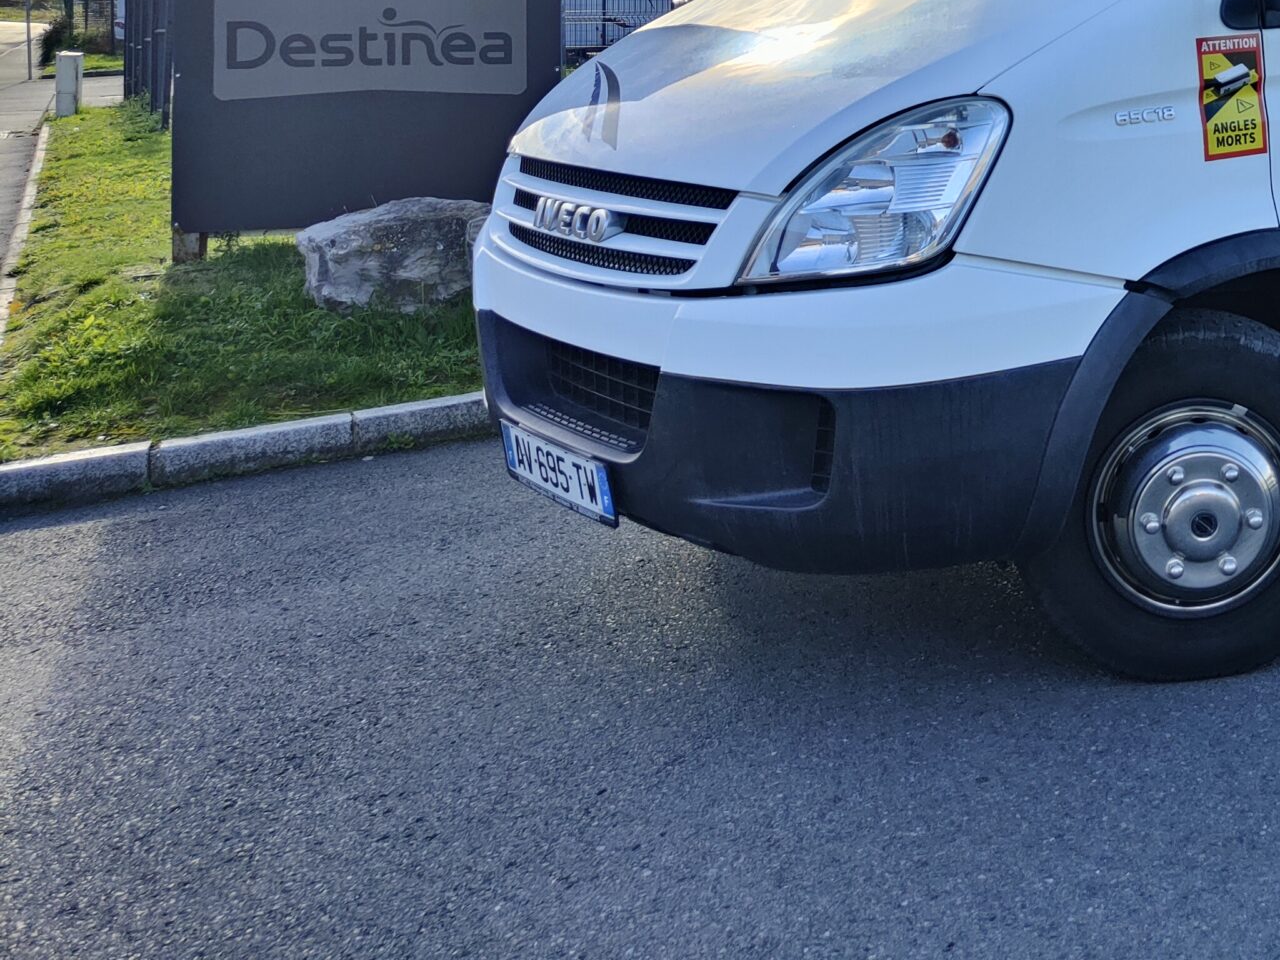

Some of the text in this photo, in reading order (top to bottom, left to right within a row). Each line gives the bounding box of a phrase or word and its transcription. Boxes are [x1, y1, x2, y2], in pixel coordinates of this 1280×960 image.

[1201, 37, 1257, 52] ATTENTION
[1115, 106, 1175, 126] 65C18
[1213, 118, 1257, 135] ANGLES
[1216, 132, 1256, 149] MORTS
[533, 196, 609, 242] IVECO
